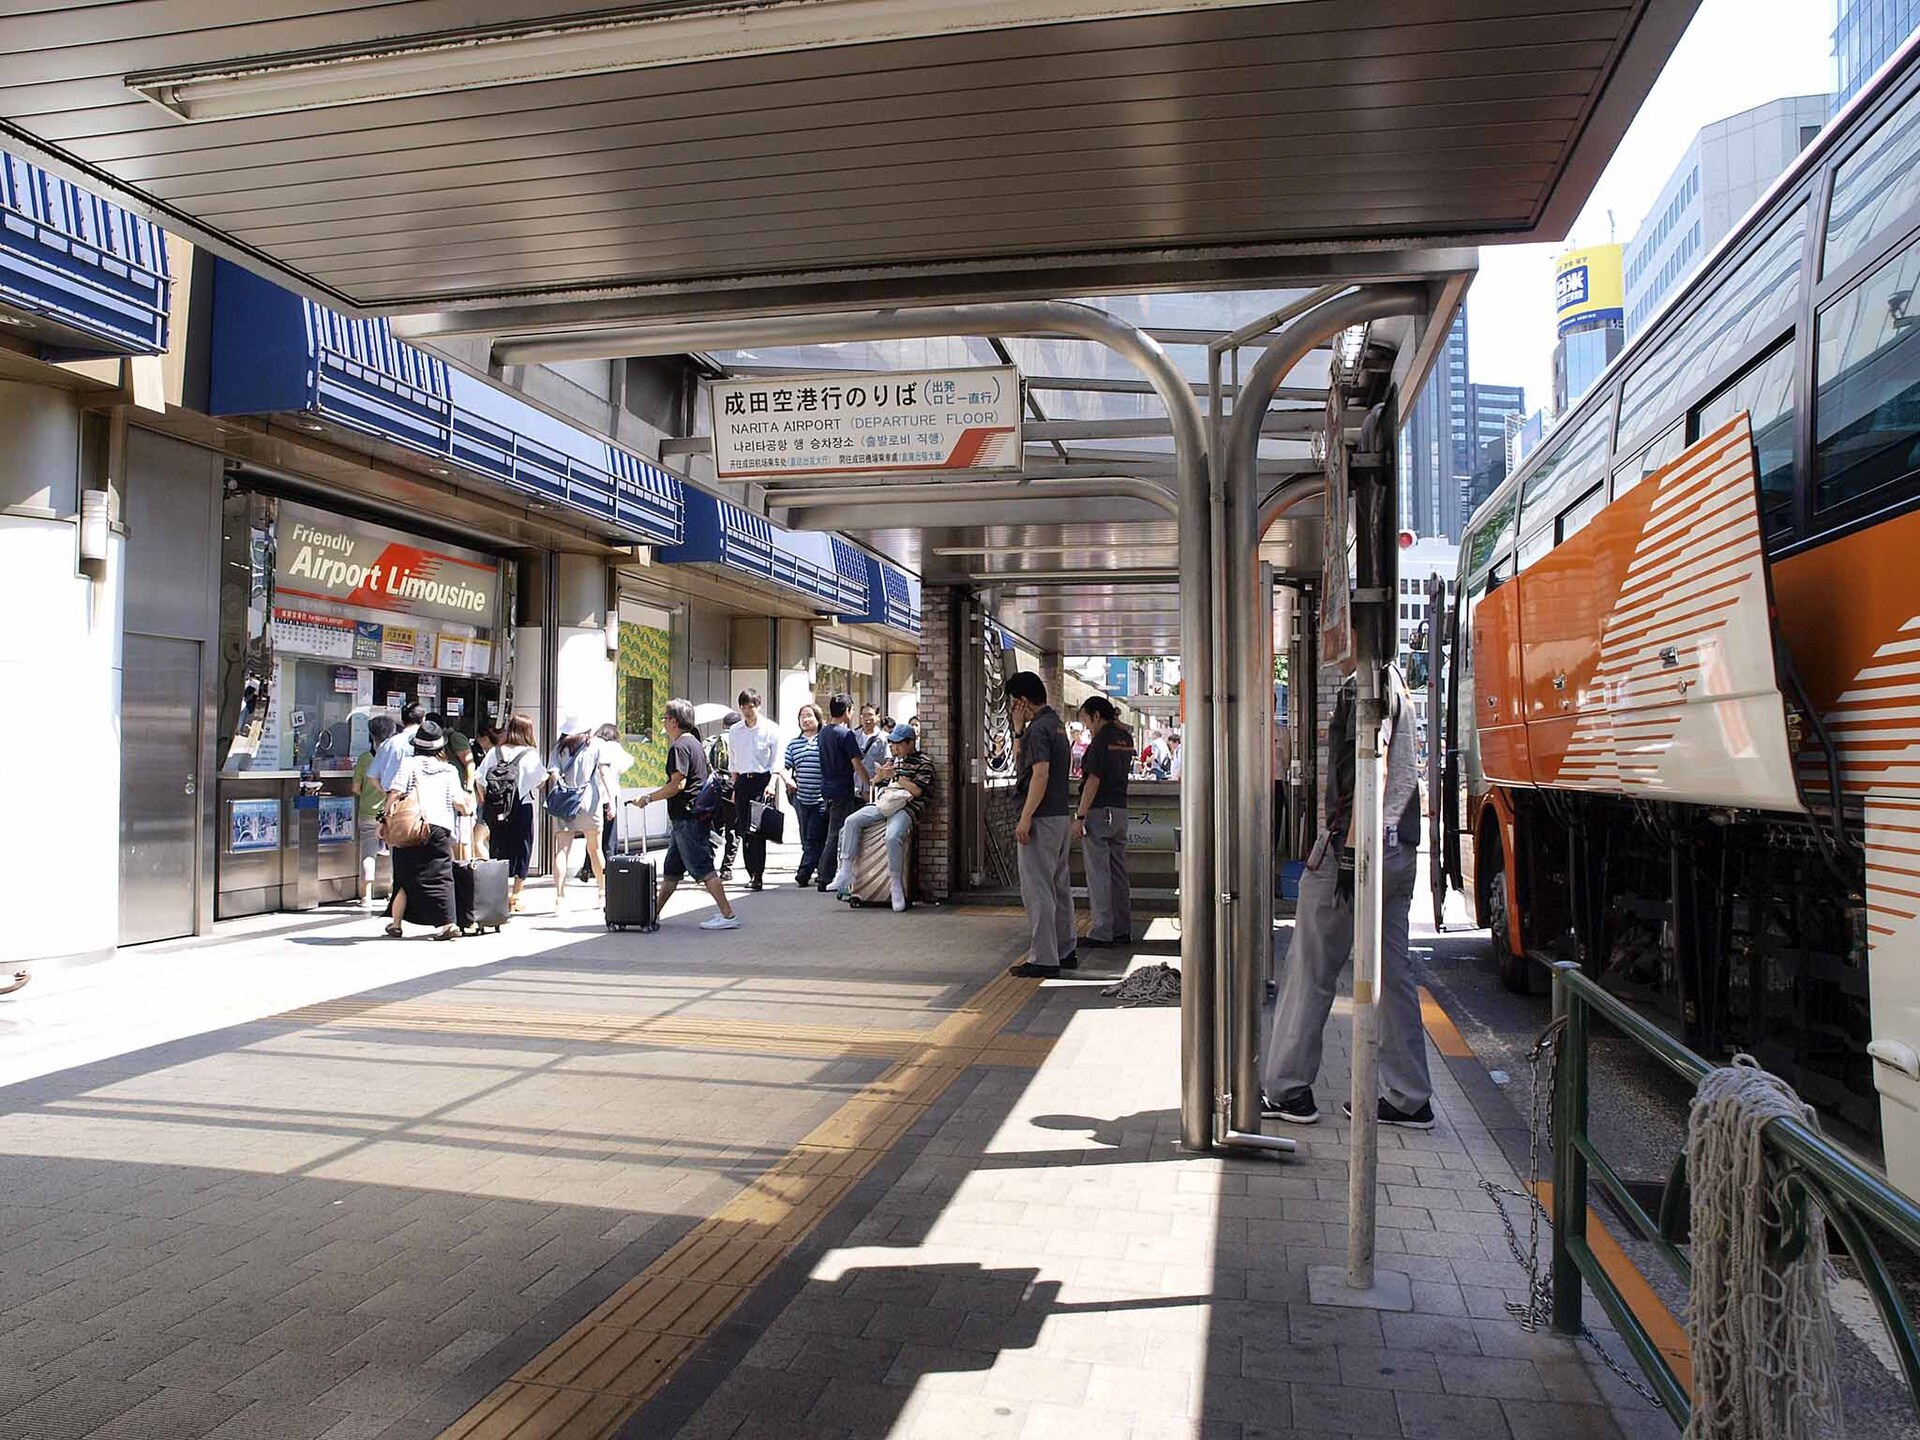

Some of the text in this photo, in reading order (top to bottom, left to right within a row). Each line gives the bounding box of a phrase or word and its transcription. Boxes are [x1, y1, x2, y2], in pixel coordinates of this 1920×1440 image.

[724, 380, 918, 416] 成田空港行のりば
[731, 411, 999, 435] NARITA AIRPORT (DEPARTURE FLOOR)
[733, 439, 787, 453] 나리타공항
[810, 437, 854, 450] 승차장소
[292, 523, 355, 558] Friendly
[288, 545, 486, 612] Airport Limousine
